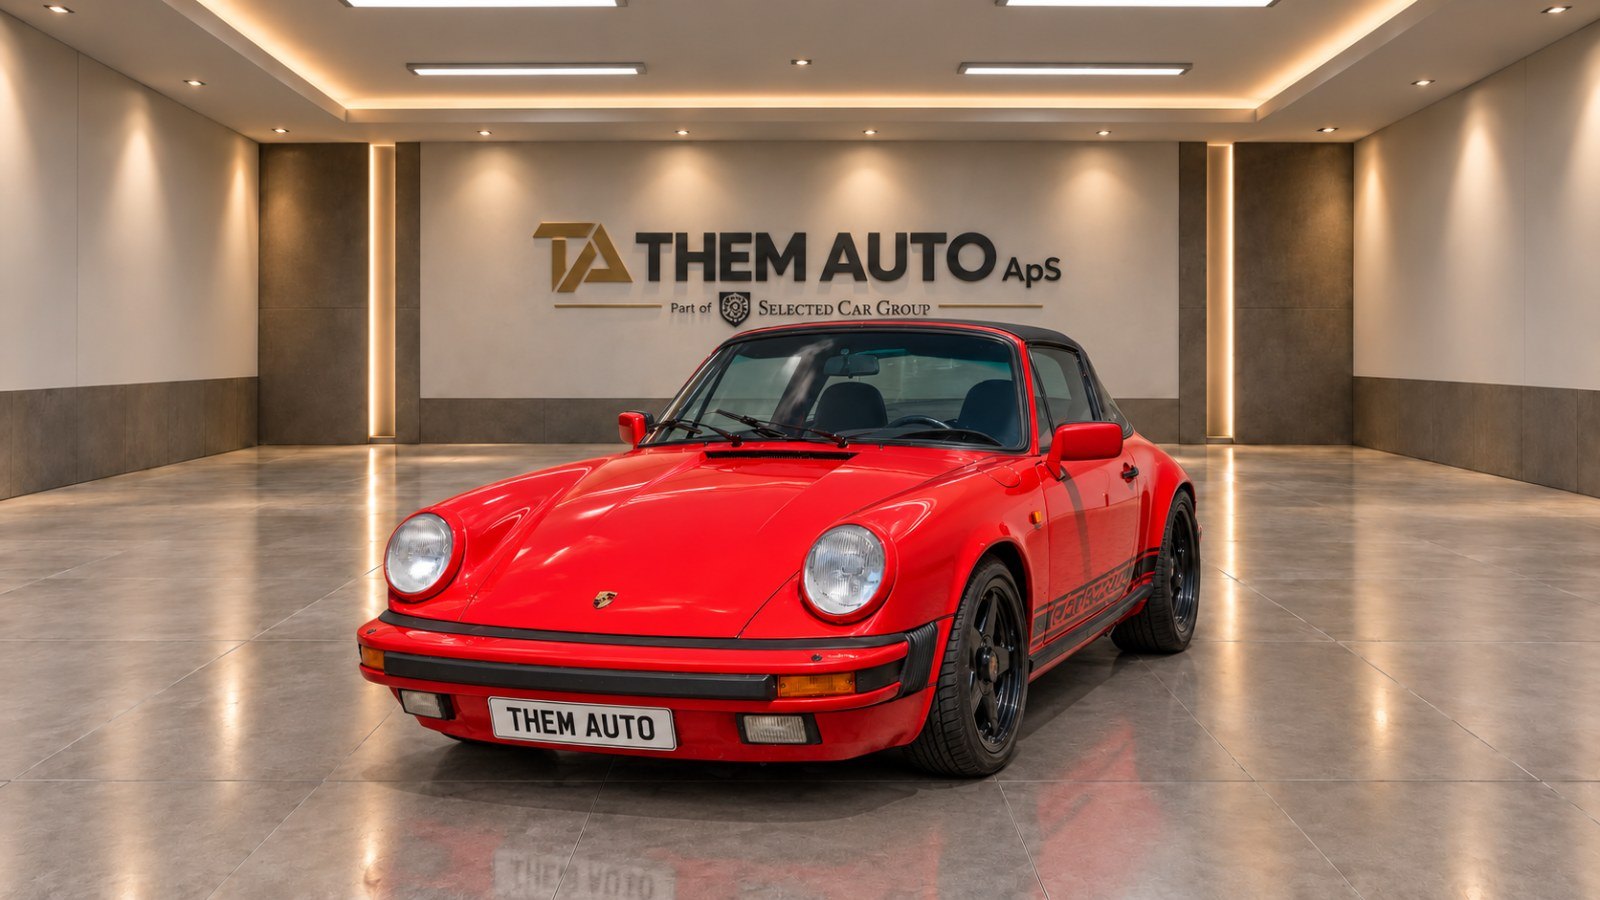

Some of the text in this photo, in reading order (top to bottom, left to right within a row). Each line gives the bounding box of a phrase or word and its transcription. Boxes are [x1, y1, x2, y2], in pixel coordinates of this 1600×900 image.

[635, 231, 1062, 289] THEM AUTO ApS
[671, 300, 931, 316] Part of SELECTED CAR GROUP
[506, 706, 655, 741] THEM AUTO
